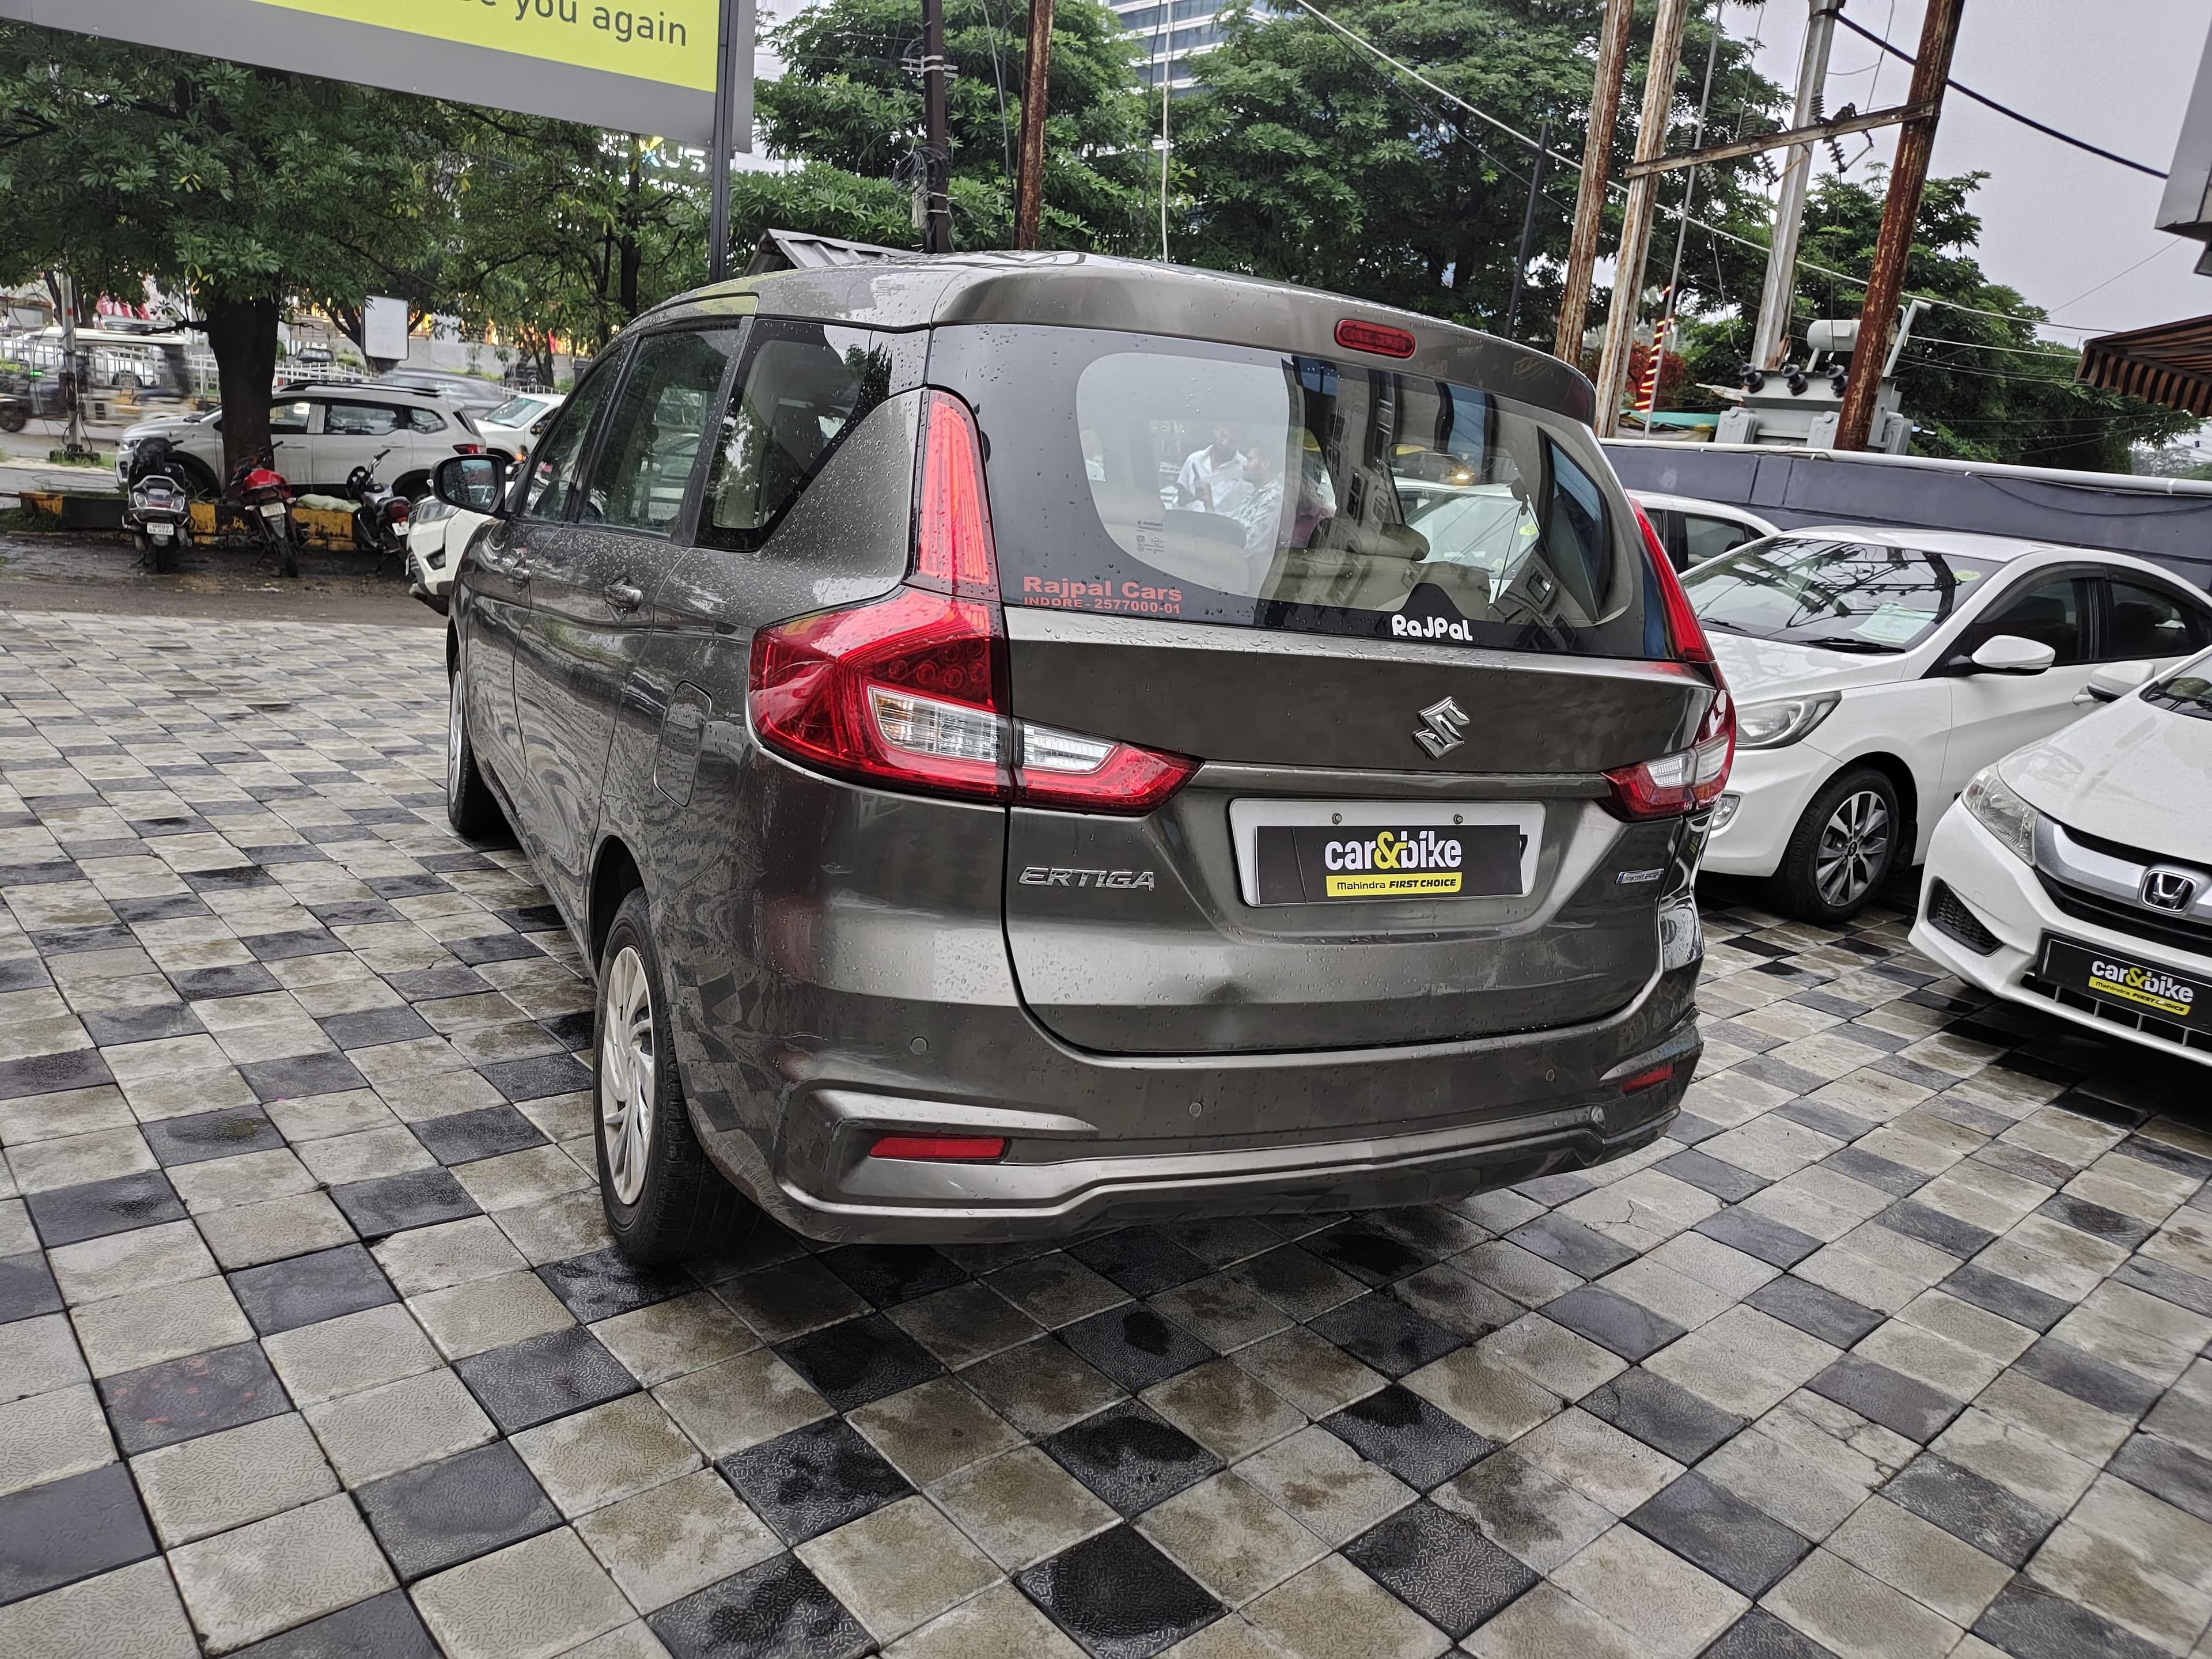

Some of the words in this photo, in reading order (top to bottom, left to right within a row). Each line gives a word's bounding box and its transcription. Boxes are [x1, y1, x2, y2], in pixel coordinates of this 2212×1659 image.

[516, 0, 577, 23] you
[593, 6, 687, 47] again
[1023, 576, 1112, 598] Rajpal
[1122, 581, 1183, 601] Cars
[1023, 596, 1083, 608] INDORE
[1094, 598, 1181, 615] 2577000-01
[1325, 831, 1463, 871] car&bike
[1018, 866, 1155, 889] ERTIGA
[1337, 881, 1386, 890] Mahindra
[1389, 880, 1419, 888] FIRST
[1420, 878, 1457, 888] CHOICE
[2092, 960, 2194, 1002] car&bike
[2132, 993, 2157, 1003] FIRST
